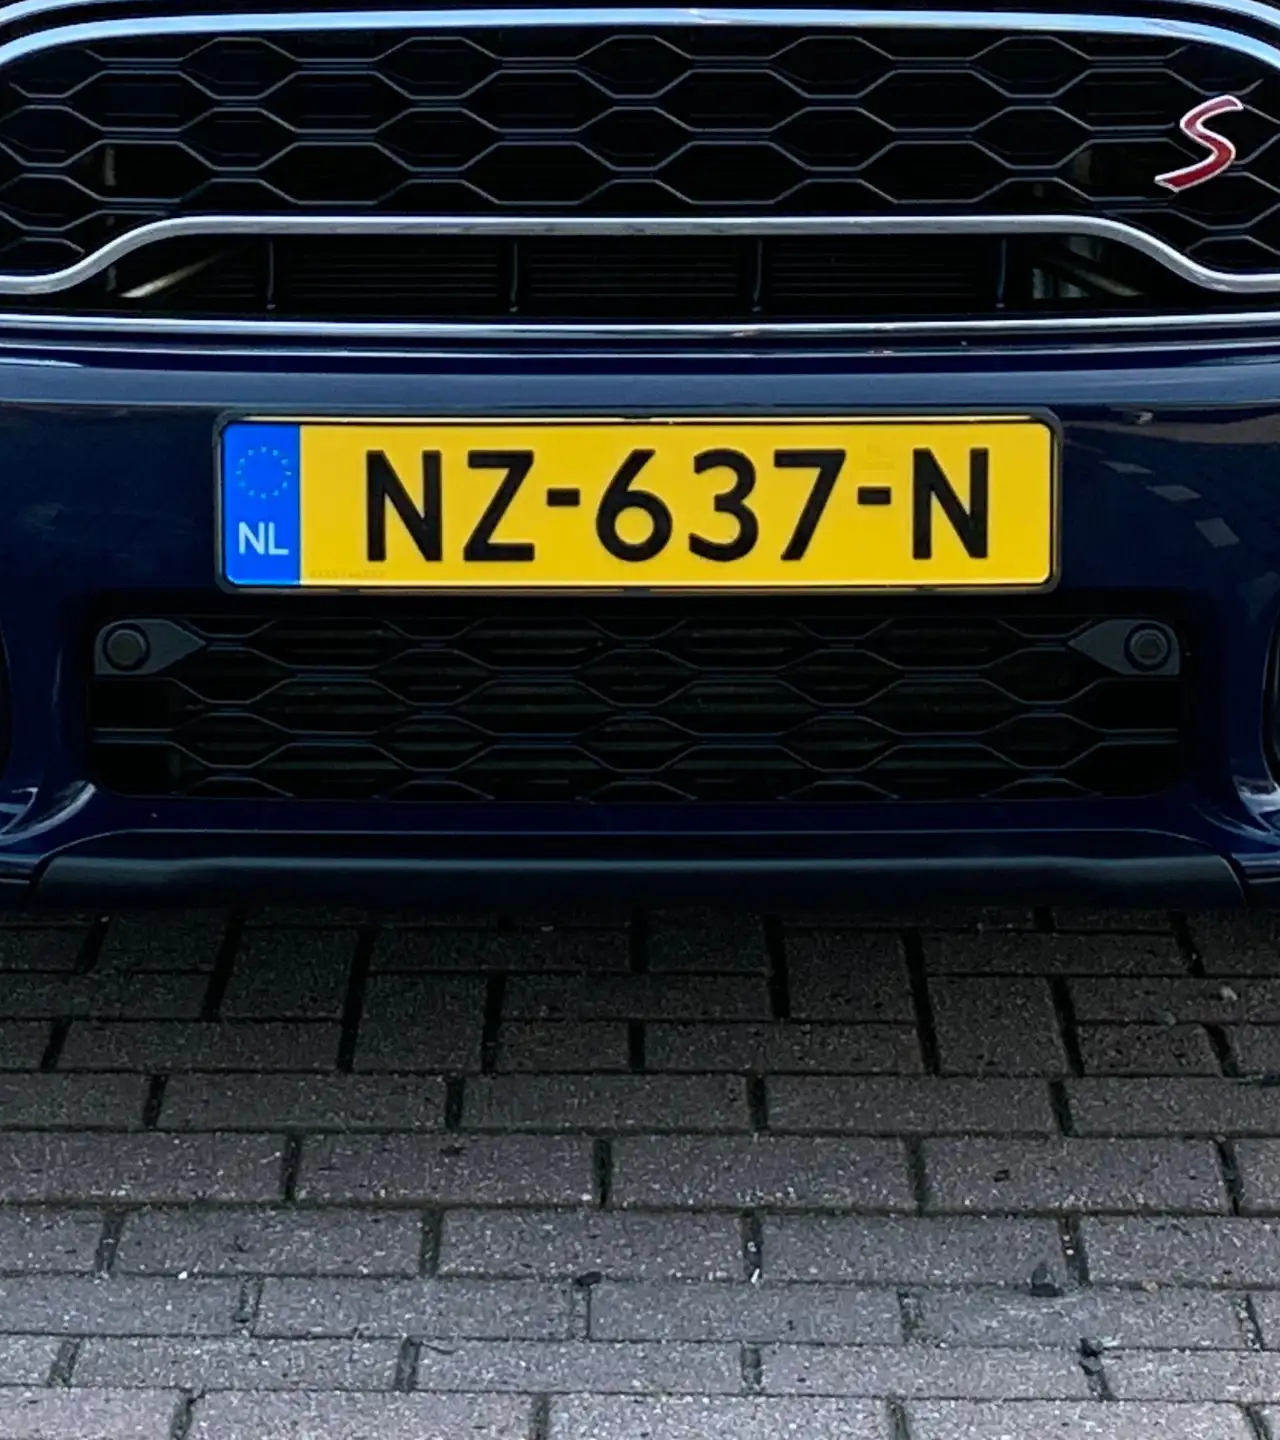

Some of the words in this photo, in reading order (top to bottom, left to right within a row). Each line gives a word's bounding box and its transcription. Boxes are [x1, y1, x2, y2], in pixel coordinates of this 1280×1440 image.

[1154, 94, 1245, 193] S
[238, 521, 290, 555] NL
[366, 447, 989, 563] NZ-637-N
